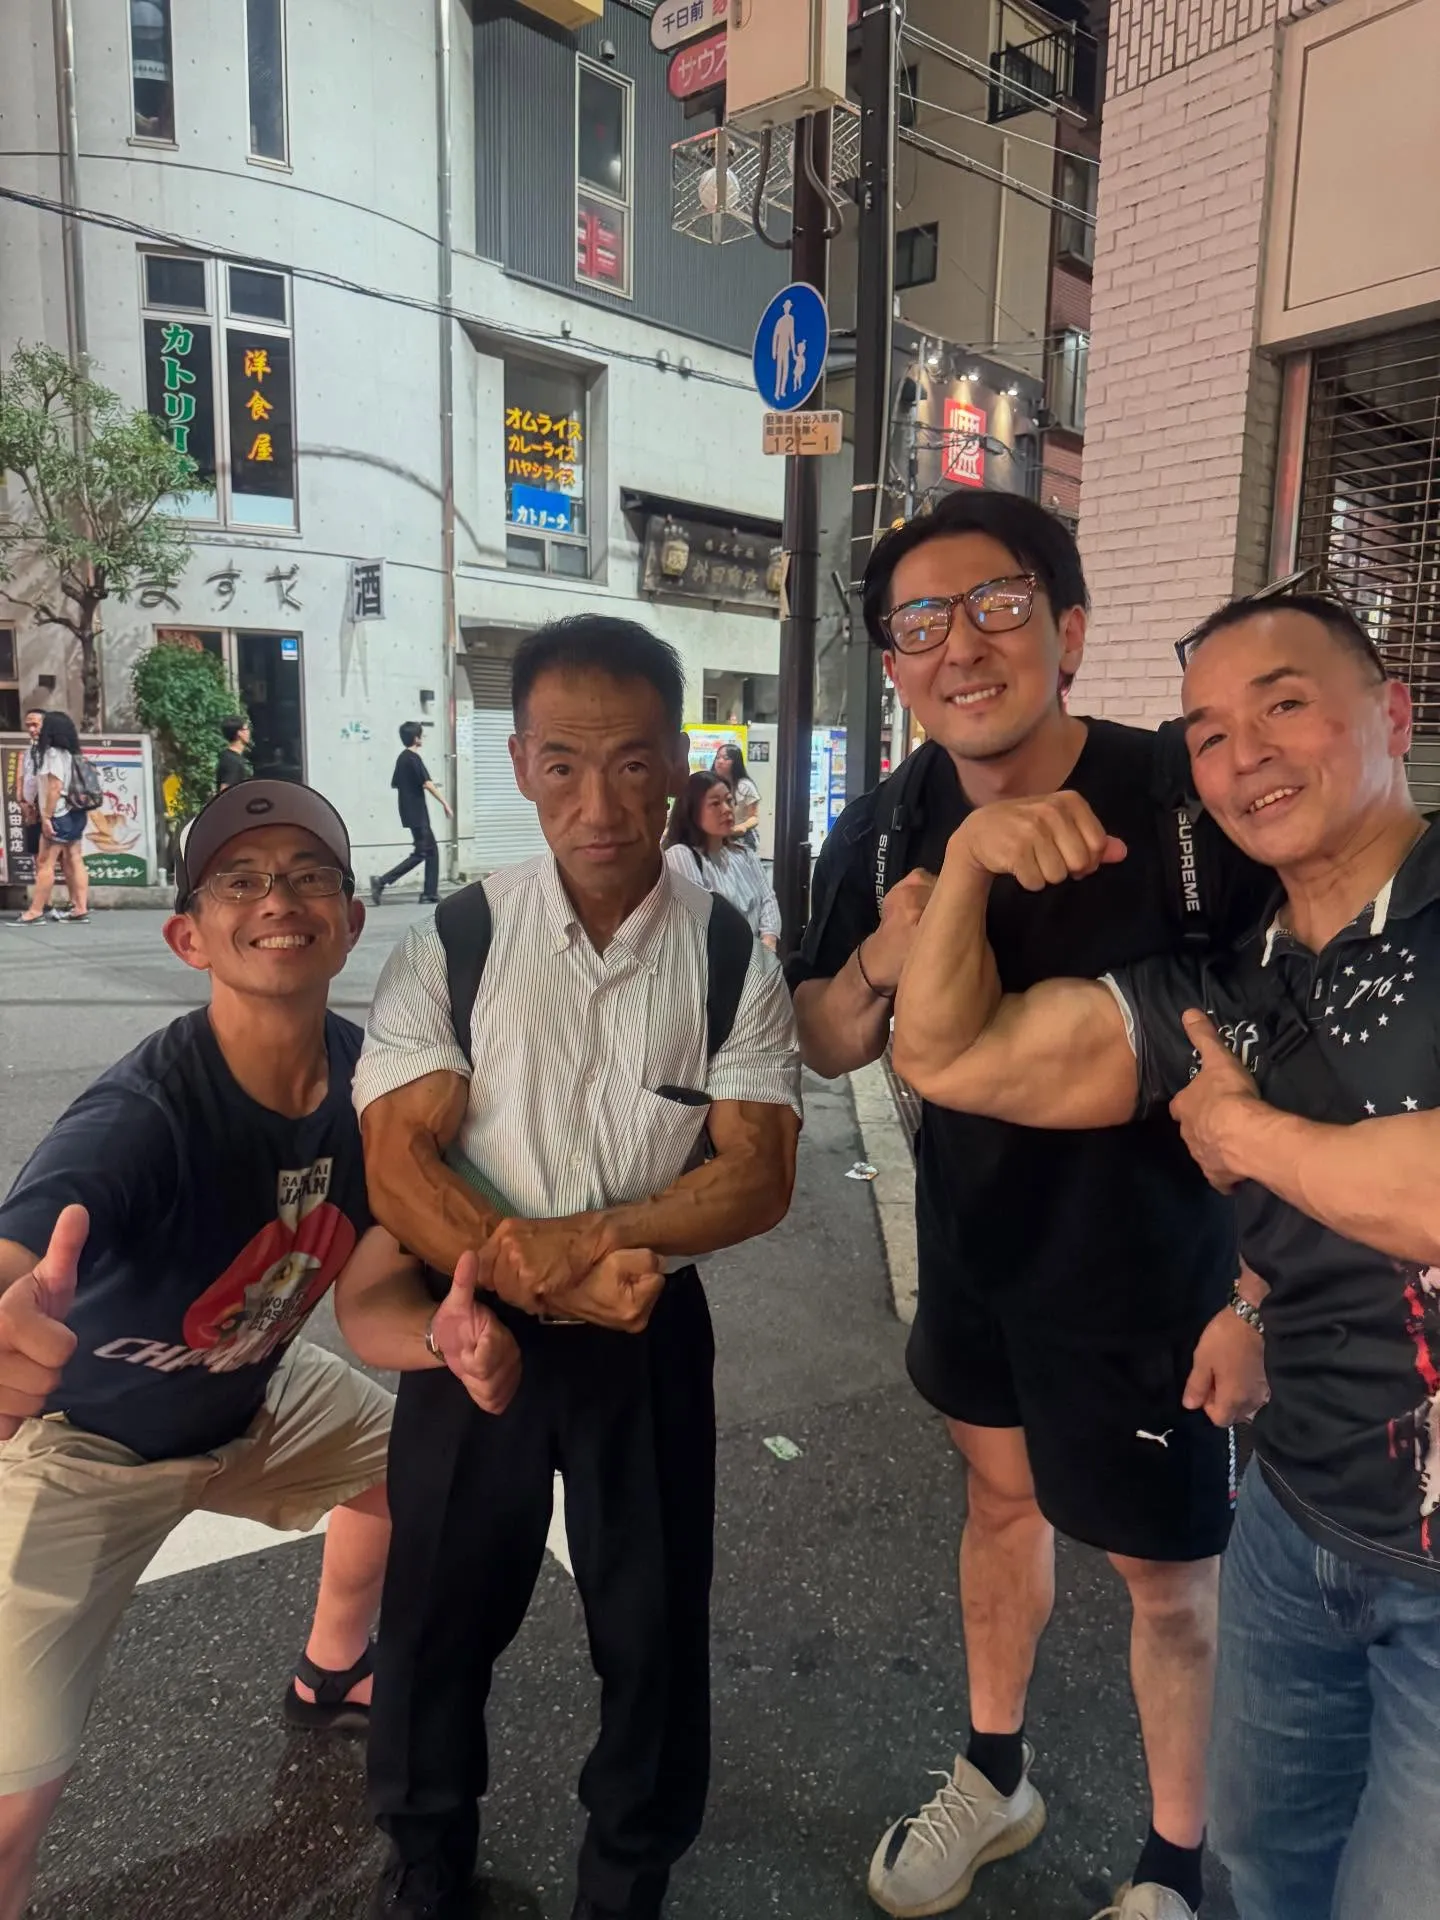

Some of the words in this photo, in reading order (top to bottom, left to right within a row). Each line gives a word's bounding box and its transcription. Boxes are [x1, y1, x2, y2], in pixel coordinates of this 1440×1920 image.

[662, 1, 704, 34] 千日前
[244, 349, 274, 462] 洋食屋
[505, 407, 583, 441] オムライス
[508, 434, 576, 462] カレーライス
[354, 563, 382, 617] 酒
[875, 833, 888, 917] SUPREM
[1178, 812, 1200, 912] SUPREME
[280, 1177, 328, 1206] JAAN
